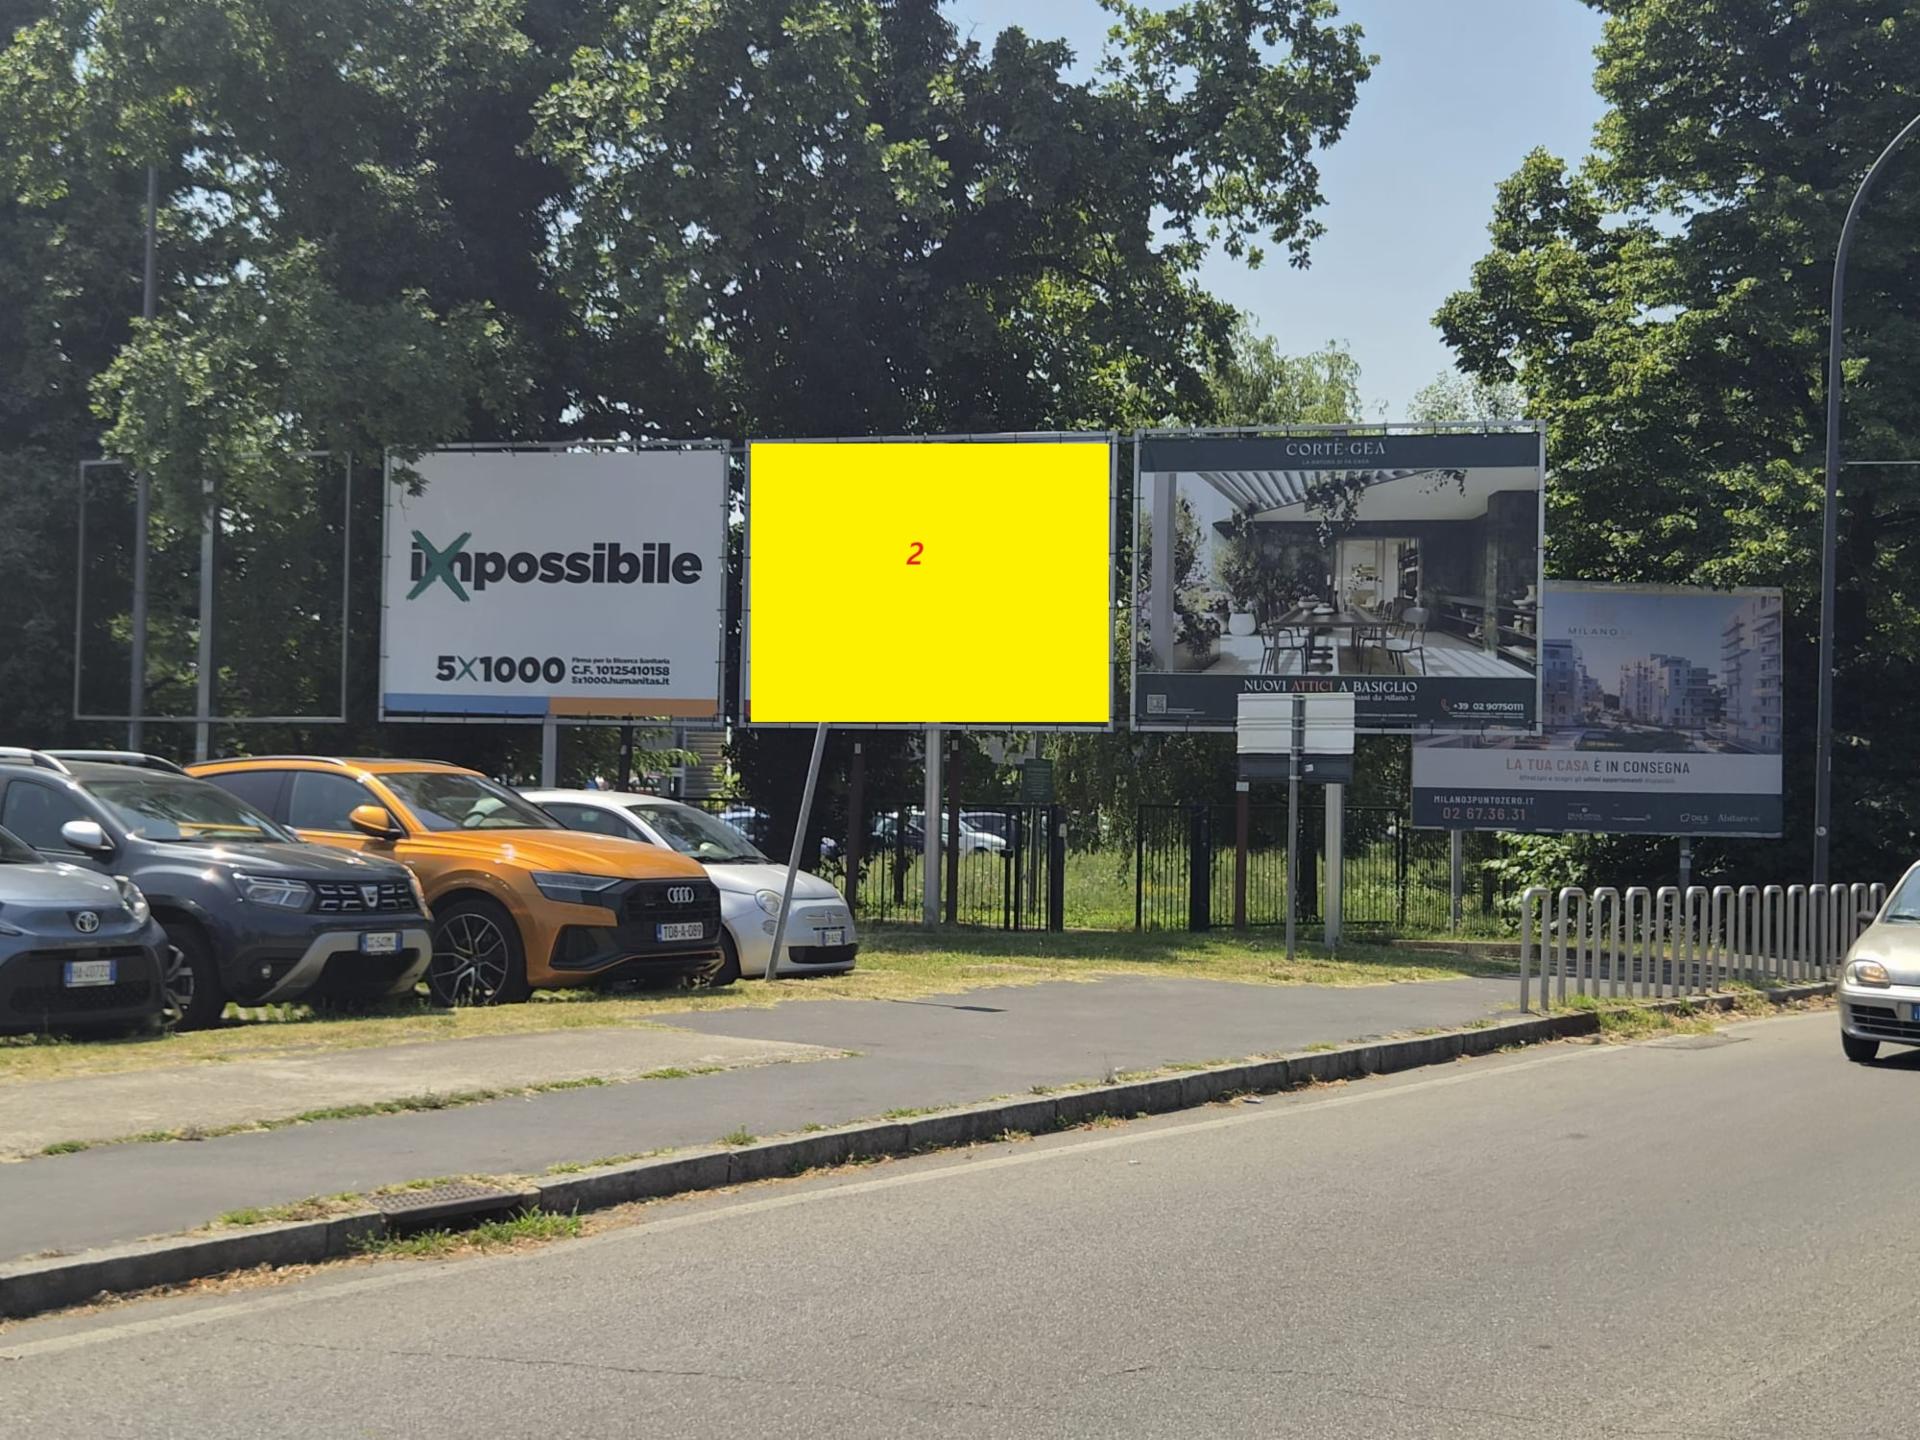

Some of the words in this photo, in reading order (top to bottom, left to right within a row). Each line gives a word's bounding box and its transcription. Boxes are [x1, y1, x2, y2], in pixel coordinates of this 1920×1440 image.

[571, 665, 594, 675] C.F.
[597, 666, 670, 676] 10125410158
[1244, 680, 1287, 692] NUOVI
[1291, 680, 1334, 692] ATTICI
[1338, 681, 1349, 692] A
[1353, 681, 1418, 693] BASIGLIO
[1472, 703, 1485, 711] 02
[1506, 758, 1522, 770] LA
[1528, 758, 1553, 771] TUA
[1557, 759, 1590, 772] CASA
[1606, 761, 1619, 773] IN
[1624, 761, 1690, 774] CONSEGNA
[1442, 807, 1461, 819] 02
[1466, 807, 1526, 820] 67.36.31
